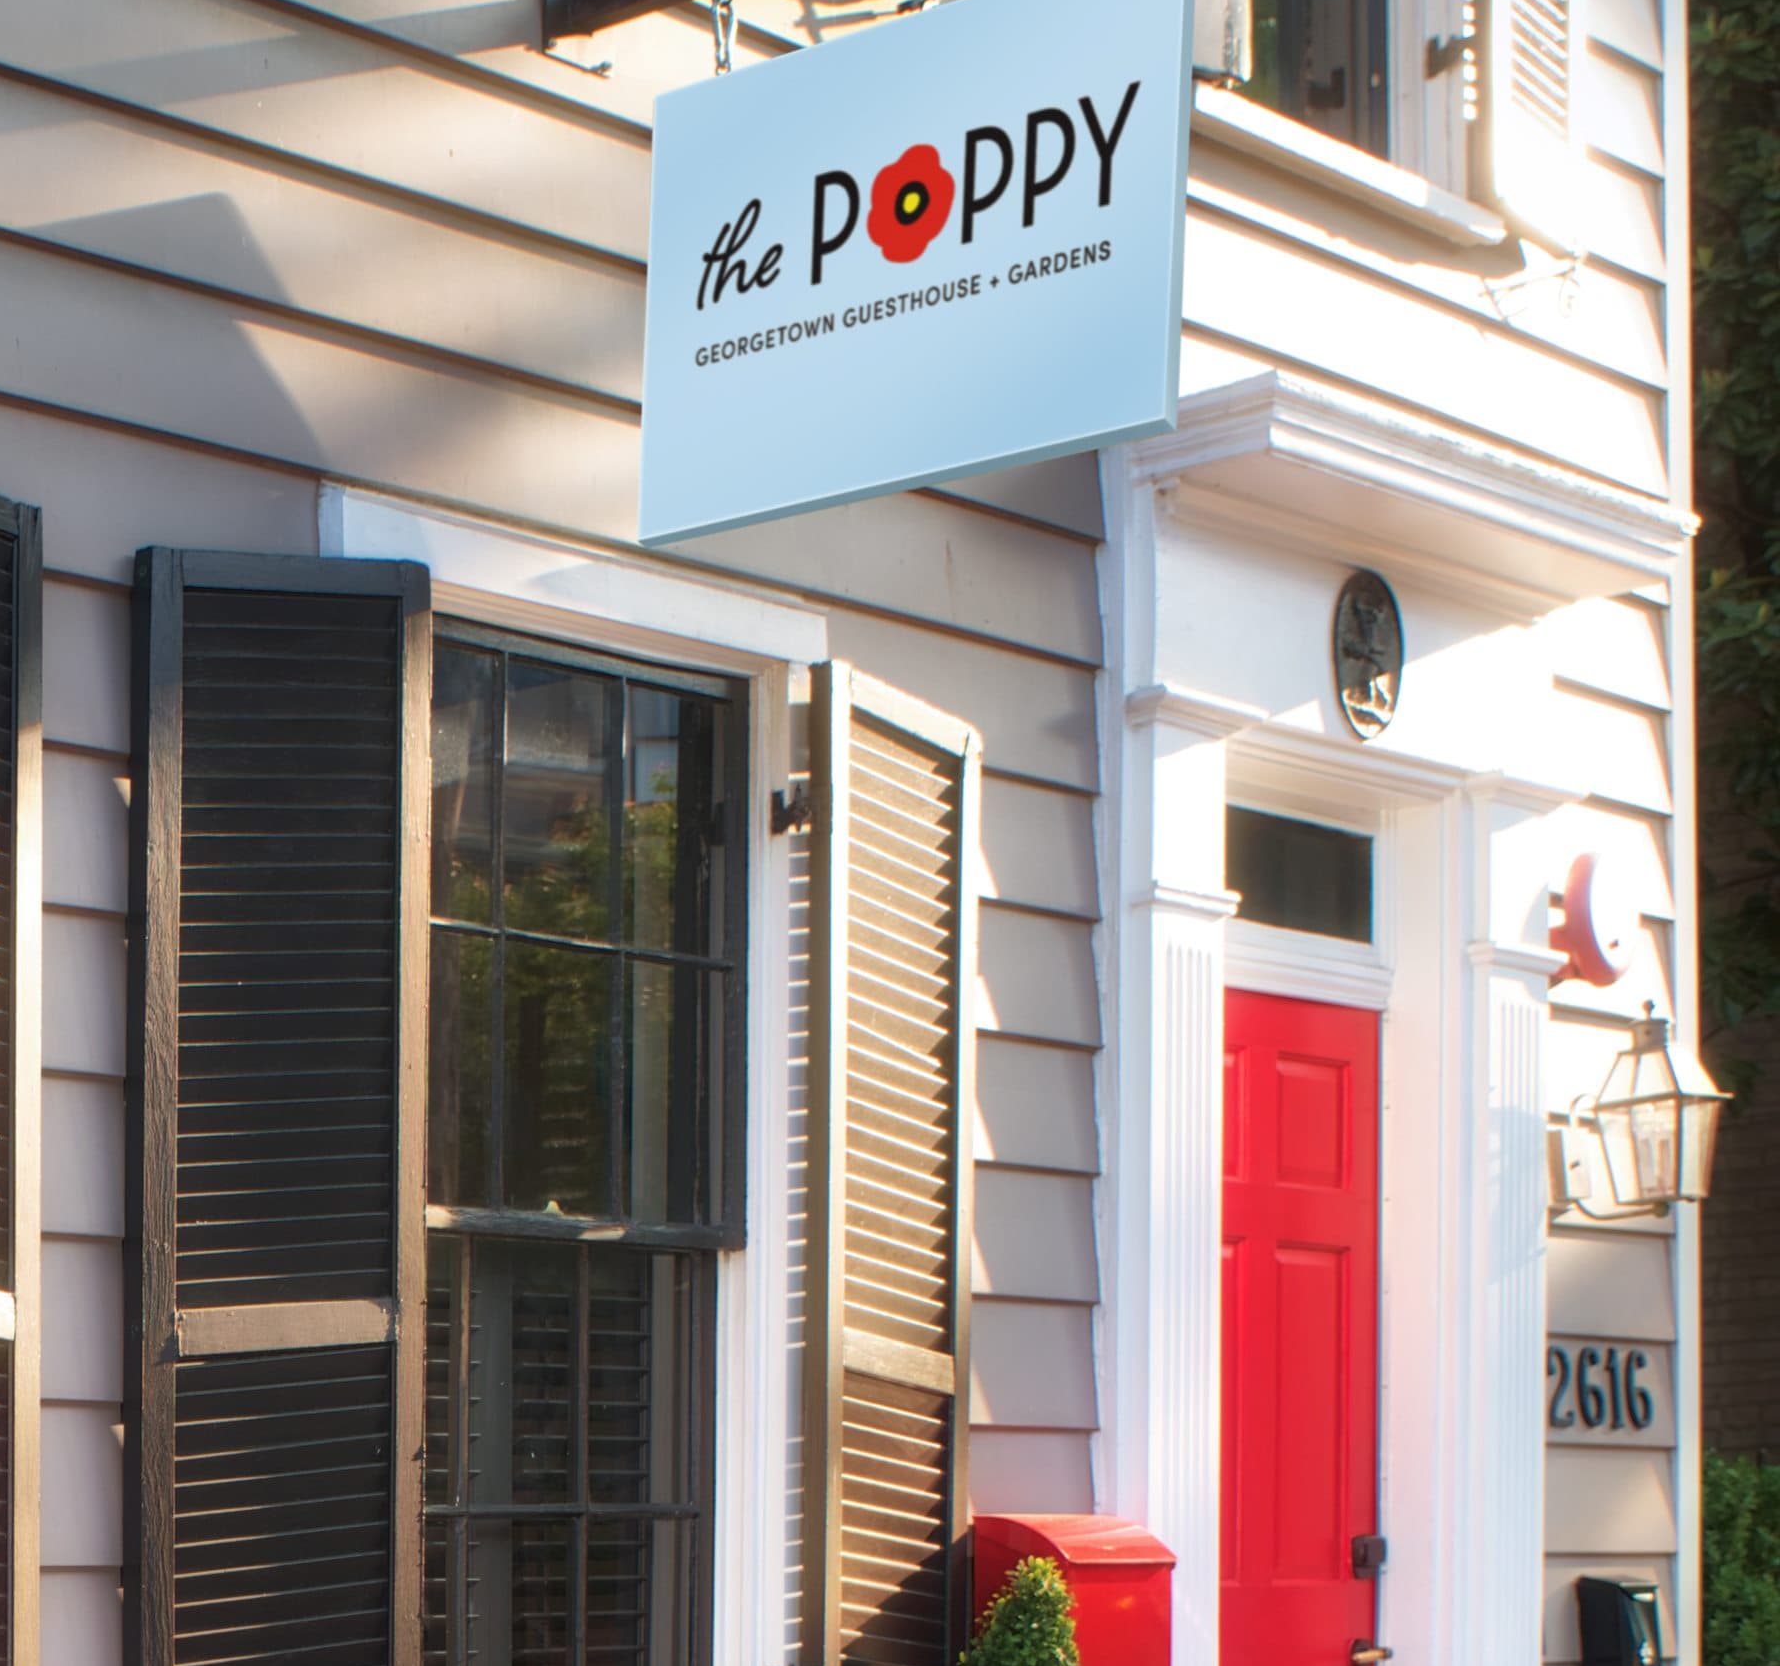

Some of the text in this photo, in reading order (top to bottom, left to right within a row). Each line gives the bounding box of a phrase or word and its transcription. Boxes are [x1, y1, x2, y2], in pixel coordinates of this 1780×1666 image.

[696, 80, 1142, 311] the POPPY
[694, 314, 836, 368] GEORGETOWN
[842, 274, 982, 329] GUESTHOUSE
[1008, 239, 1112, 285] GARDENS
[1546, 1345, 1654, 1431] 2616
